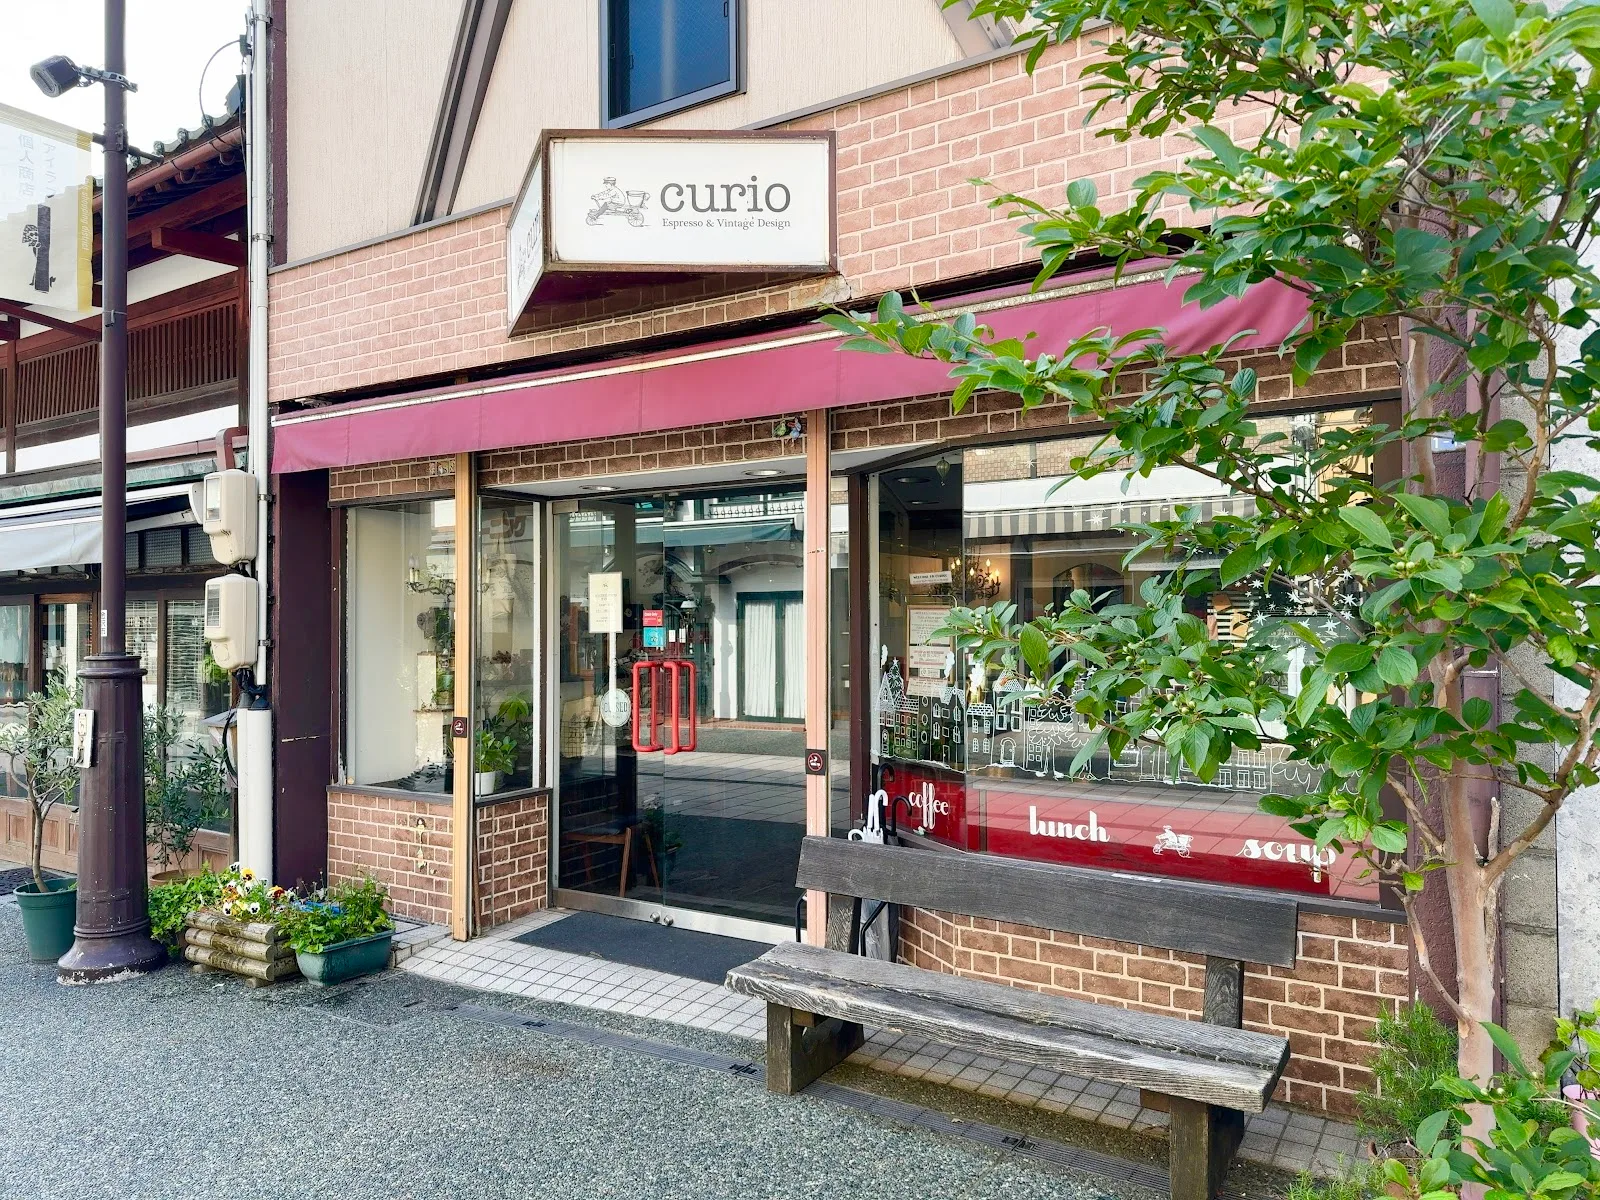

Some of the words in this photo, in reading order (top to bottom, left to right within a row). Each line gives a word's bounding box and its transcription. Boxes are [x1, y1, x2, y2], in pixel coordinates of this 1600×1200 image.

[18, 134, 35, 197] 個人商店
[660, 175, 791, 213] curio
[81, 226, 91, 251] district
[662, 218, 704, 229] Espresso
[706, 218, 715, 228] &
[717, 218, 755, 231] Vintage
[757, 218, 791, 231] Design
[908, 782, 949, 829] coffee
[1029, 805, 1110, 843] lunch
[1236, 839, 1336, 883] soup
